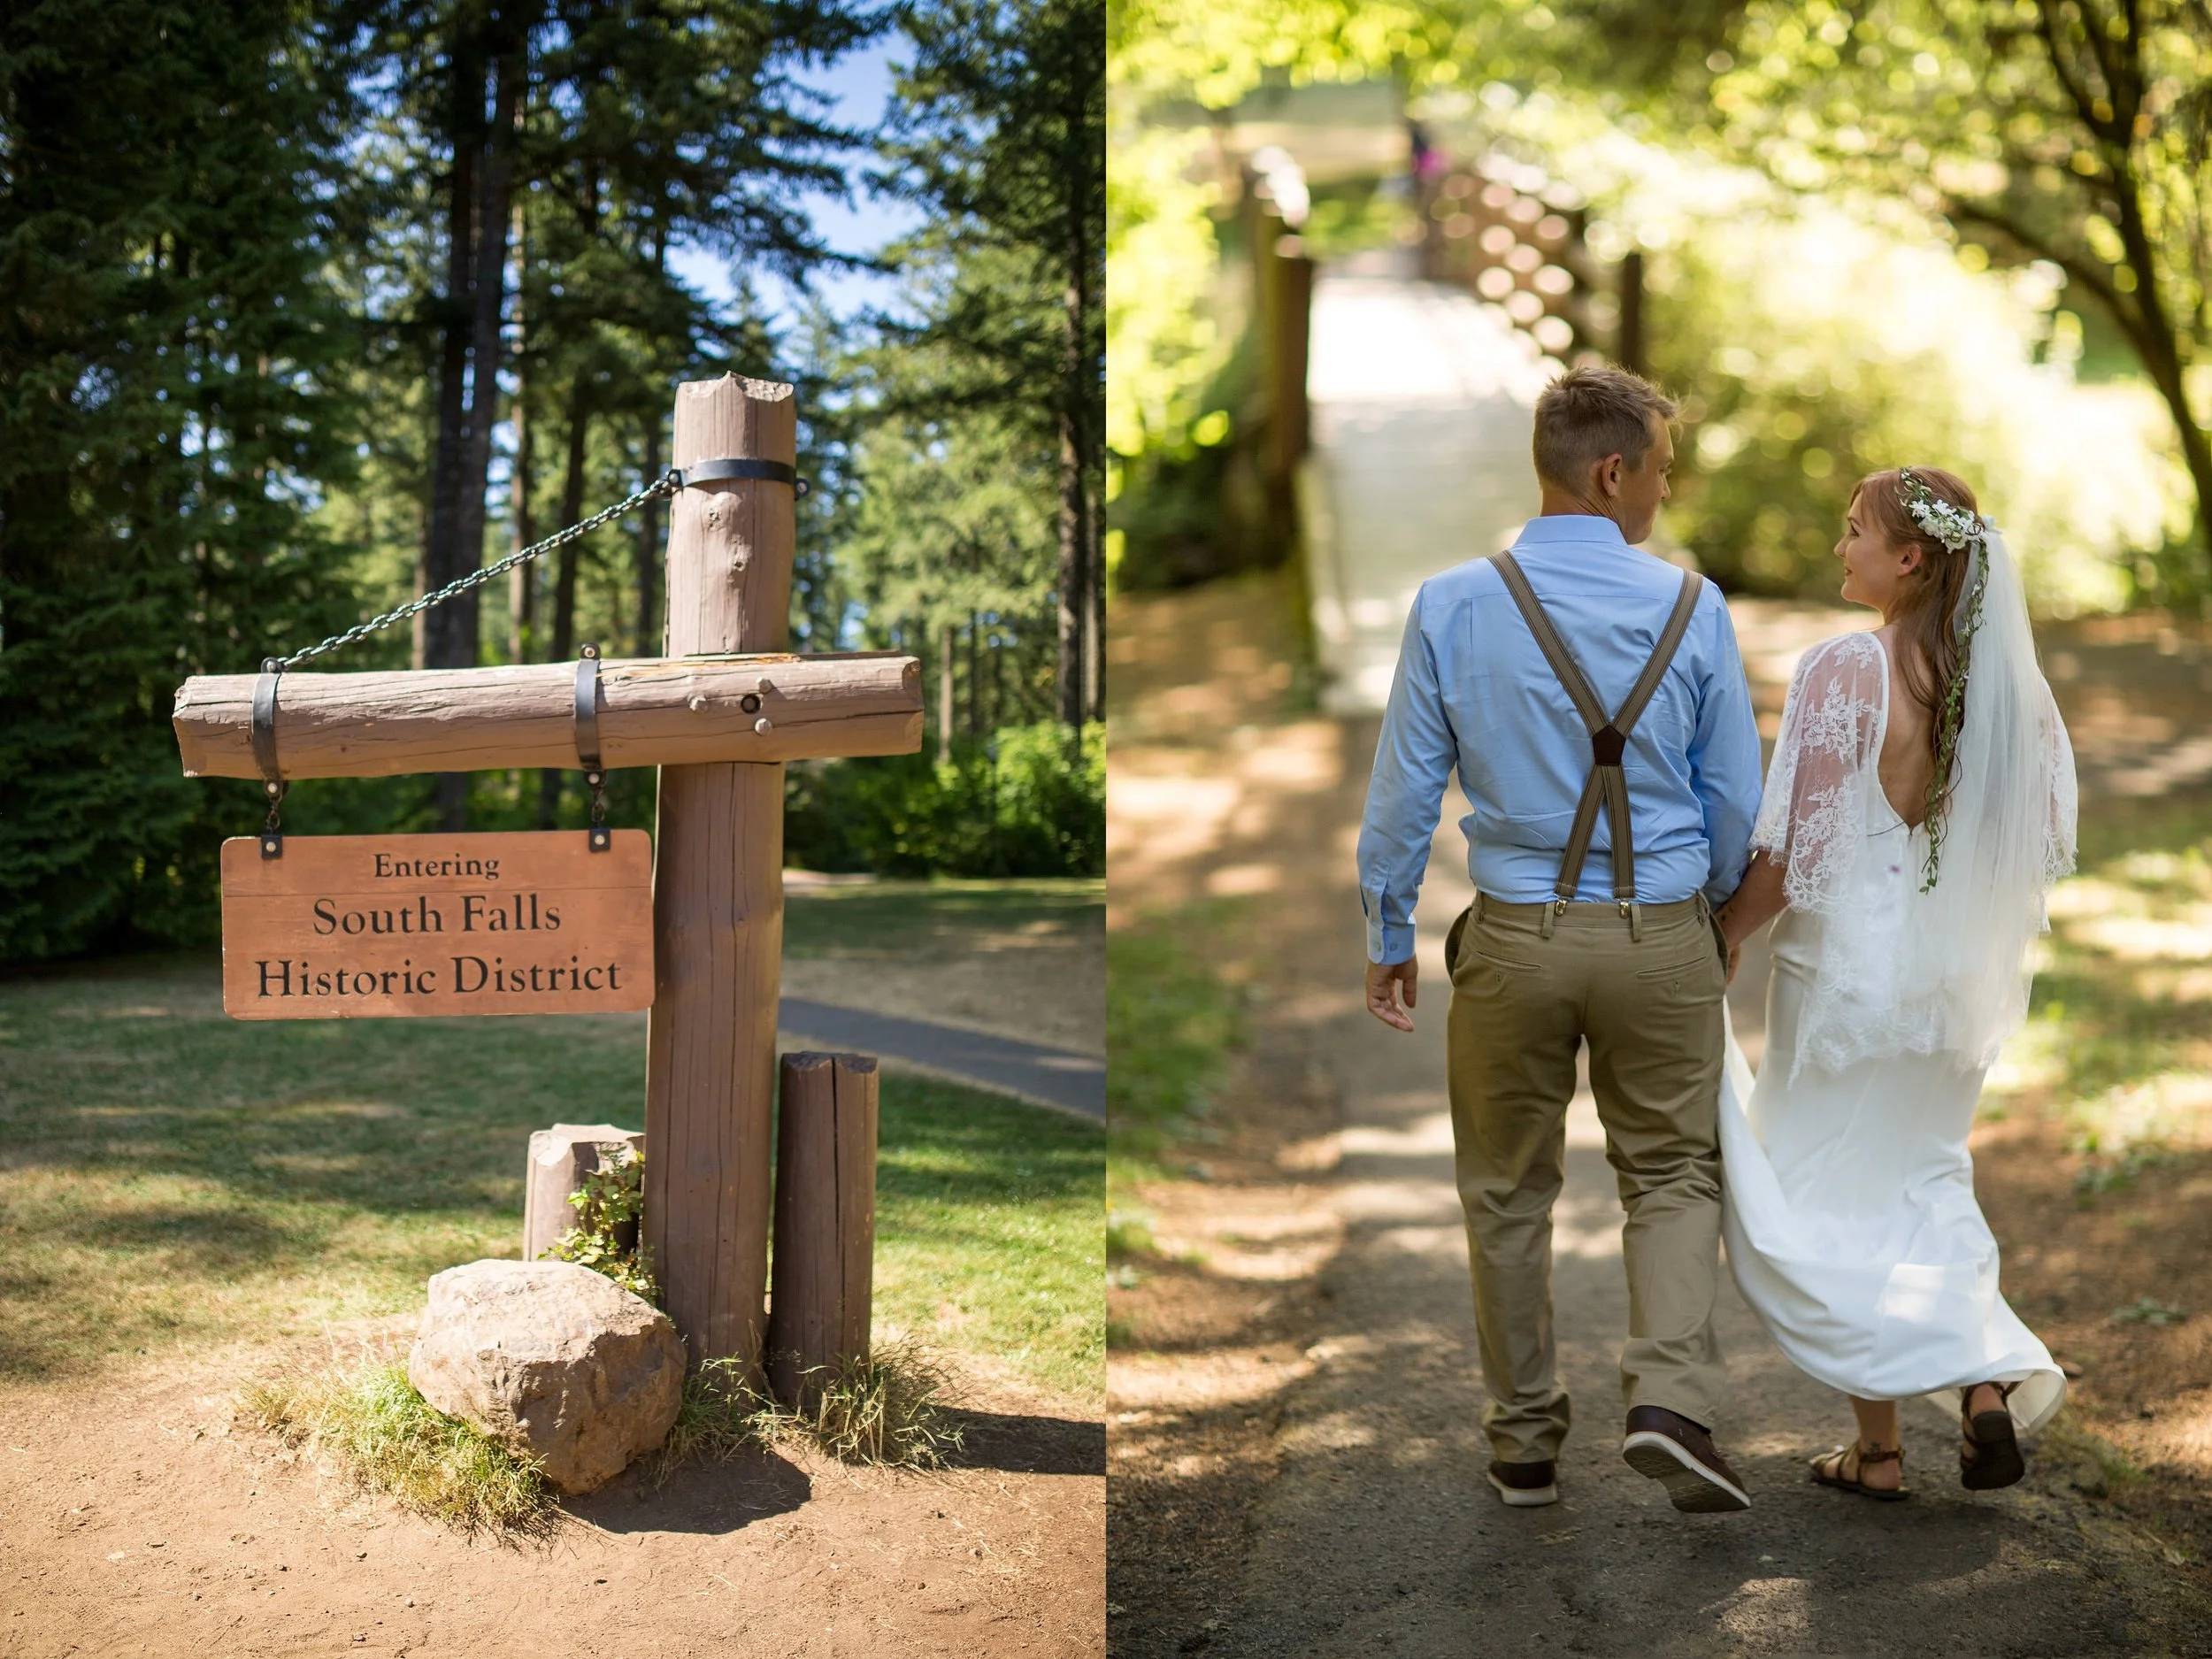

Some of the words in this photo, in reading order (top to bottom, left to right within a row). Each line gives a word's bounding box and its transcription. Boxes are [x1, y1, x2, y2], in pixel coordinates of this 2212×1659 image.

[373, 853, 501, 880] Entering
[313, 895, 444, 935] South
[460, 892, 562, 933] Falls
[254, 958, 437, 998] Historic
[449, 955, 623, 994] District
